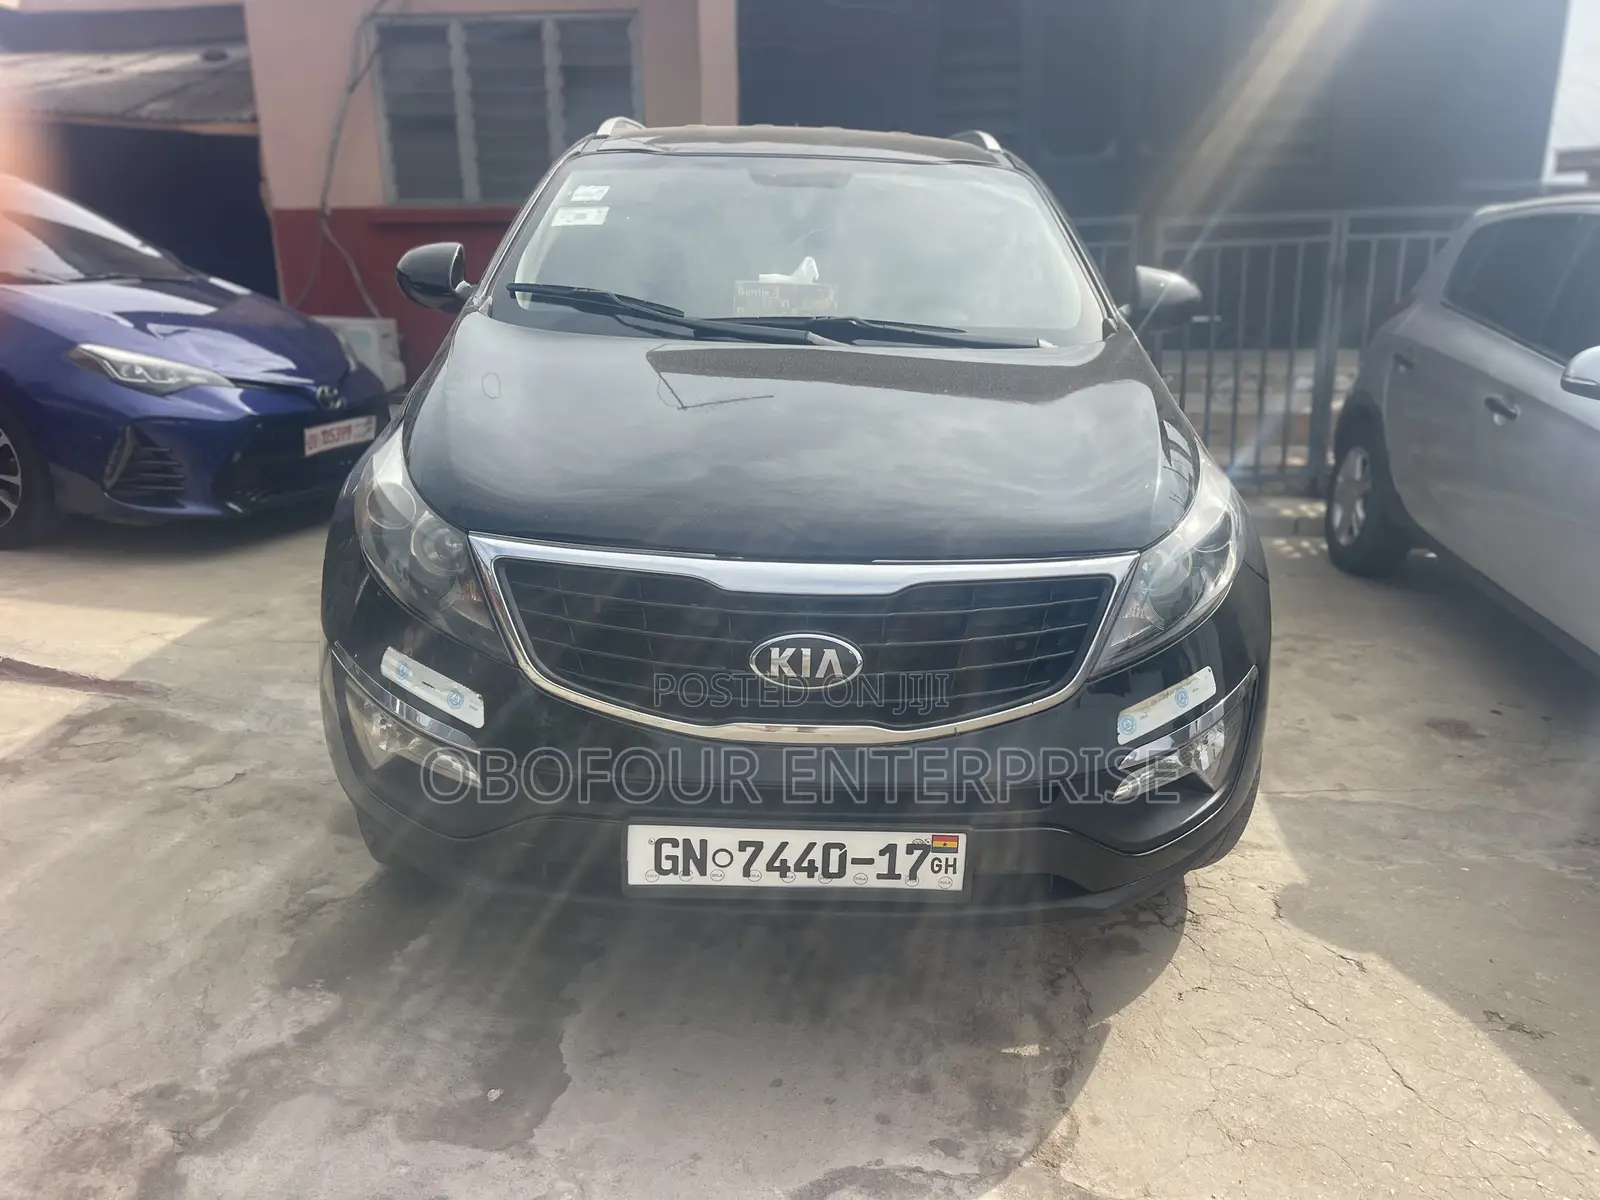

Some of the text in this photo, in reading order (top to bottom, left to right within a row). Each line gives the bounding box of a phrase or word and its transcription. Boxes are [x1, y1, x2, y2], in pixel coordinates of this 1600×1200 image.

[769, 647, 844, 679] KIA
[738, 840, 932, 880] 7440-17
[930, 856, 957, 875] GH
